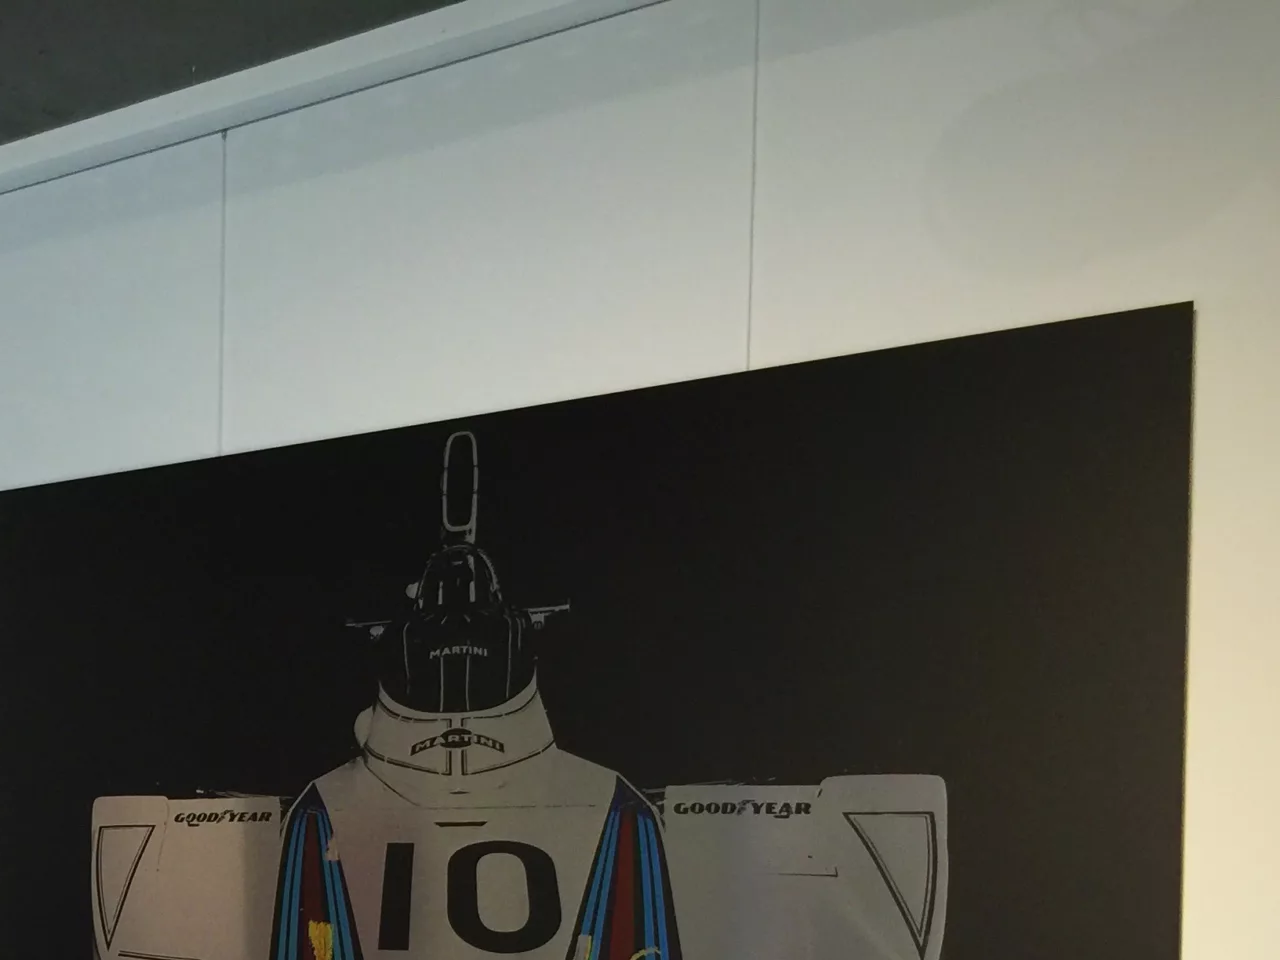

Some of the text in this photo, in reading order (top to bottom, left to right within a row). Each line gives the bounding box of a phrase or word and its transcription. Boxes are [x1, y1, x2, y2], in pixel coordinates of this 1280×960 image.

[429, 645, 489, 660] MARTINI
[413, 734, 503, 755] MARTINI
[376, 839, 563, 955] 10
